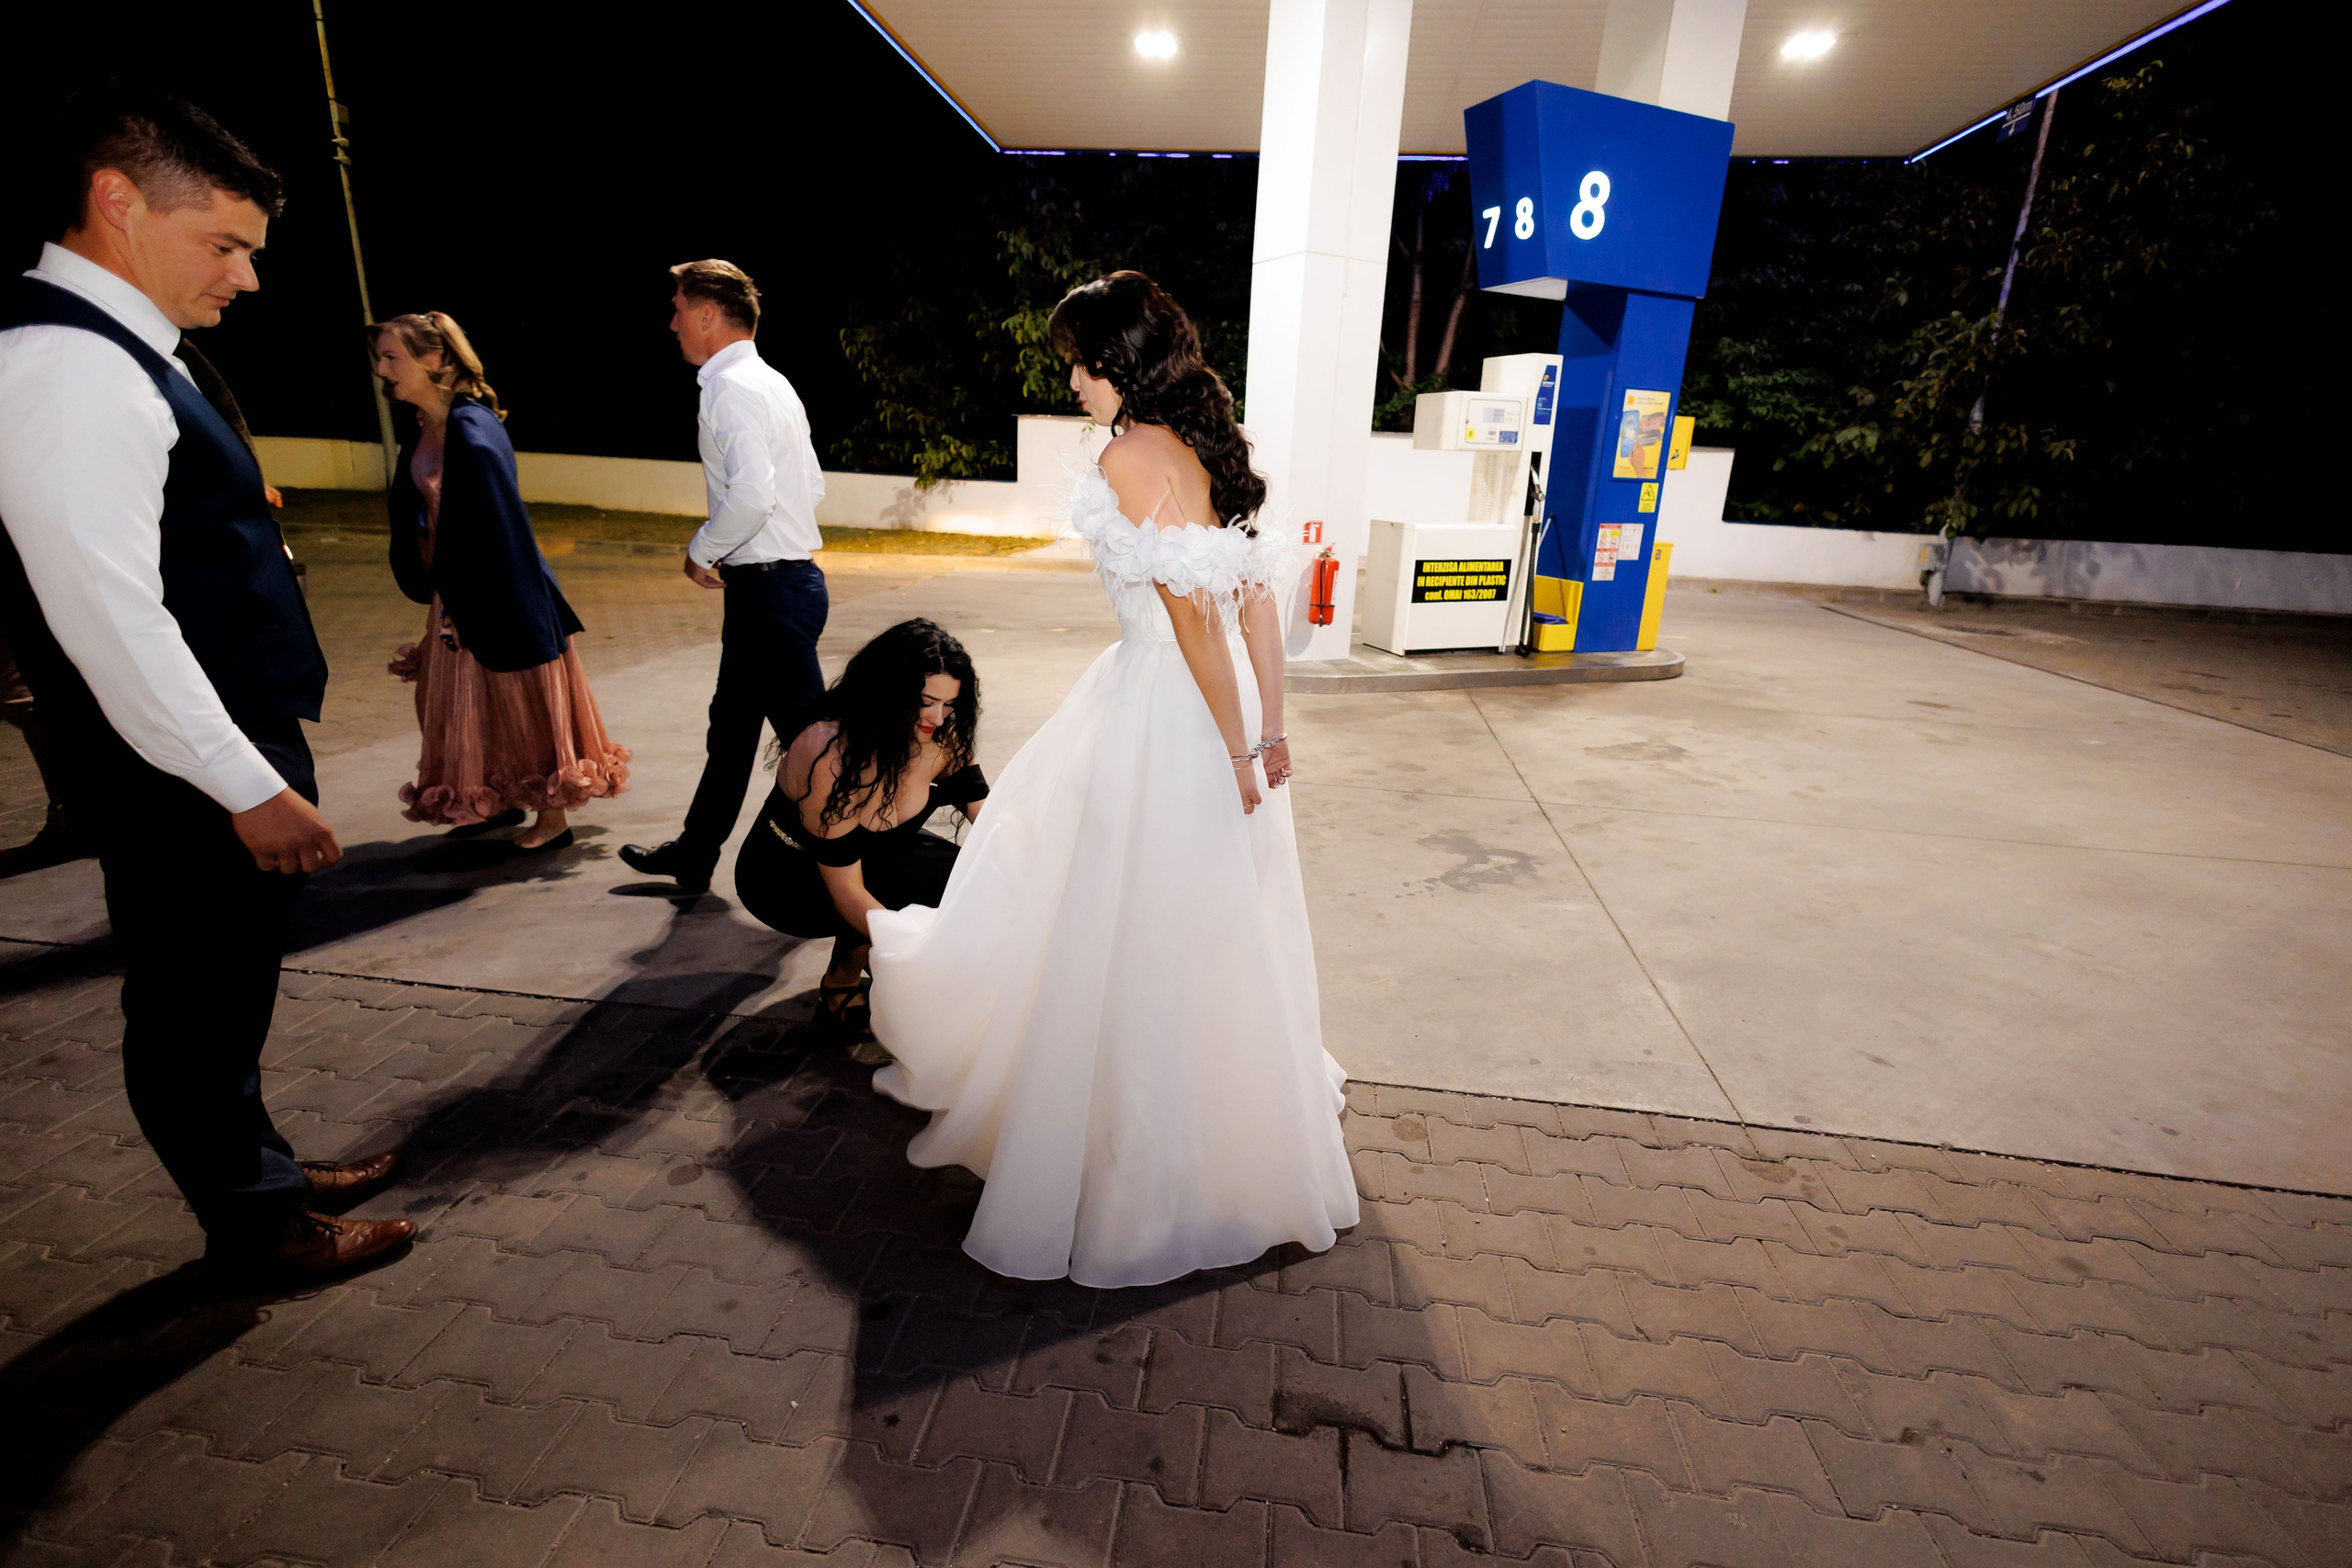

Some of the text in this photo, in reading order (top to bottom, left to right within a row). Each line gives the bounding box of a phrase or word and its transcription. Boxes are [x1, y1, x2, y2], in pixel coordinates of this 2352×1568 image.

[1569, 170, 1611, 240] 8
[1482, 197, 1535, 250] 7 8
[1422, 561, 1504, 573] INTERZISA ALIMENTAREA
[1417, 575, 1507, 587] IN RECIPIENTE DIN PLASTIC
[1425, 589, 1497, 601] conf. OMAI 163/2007
